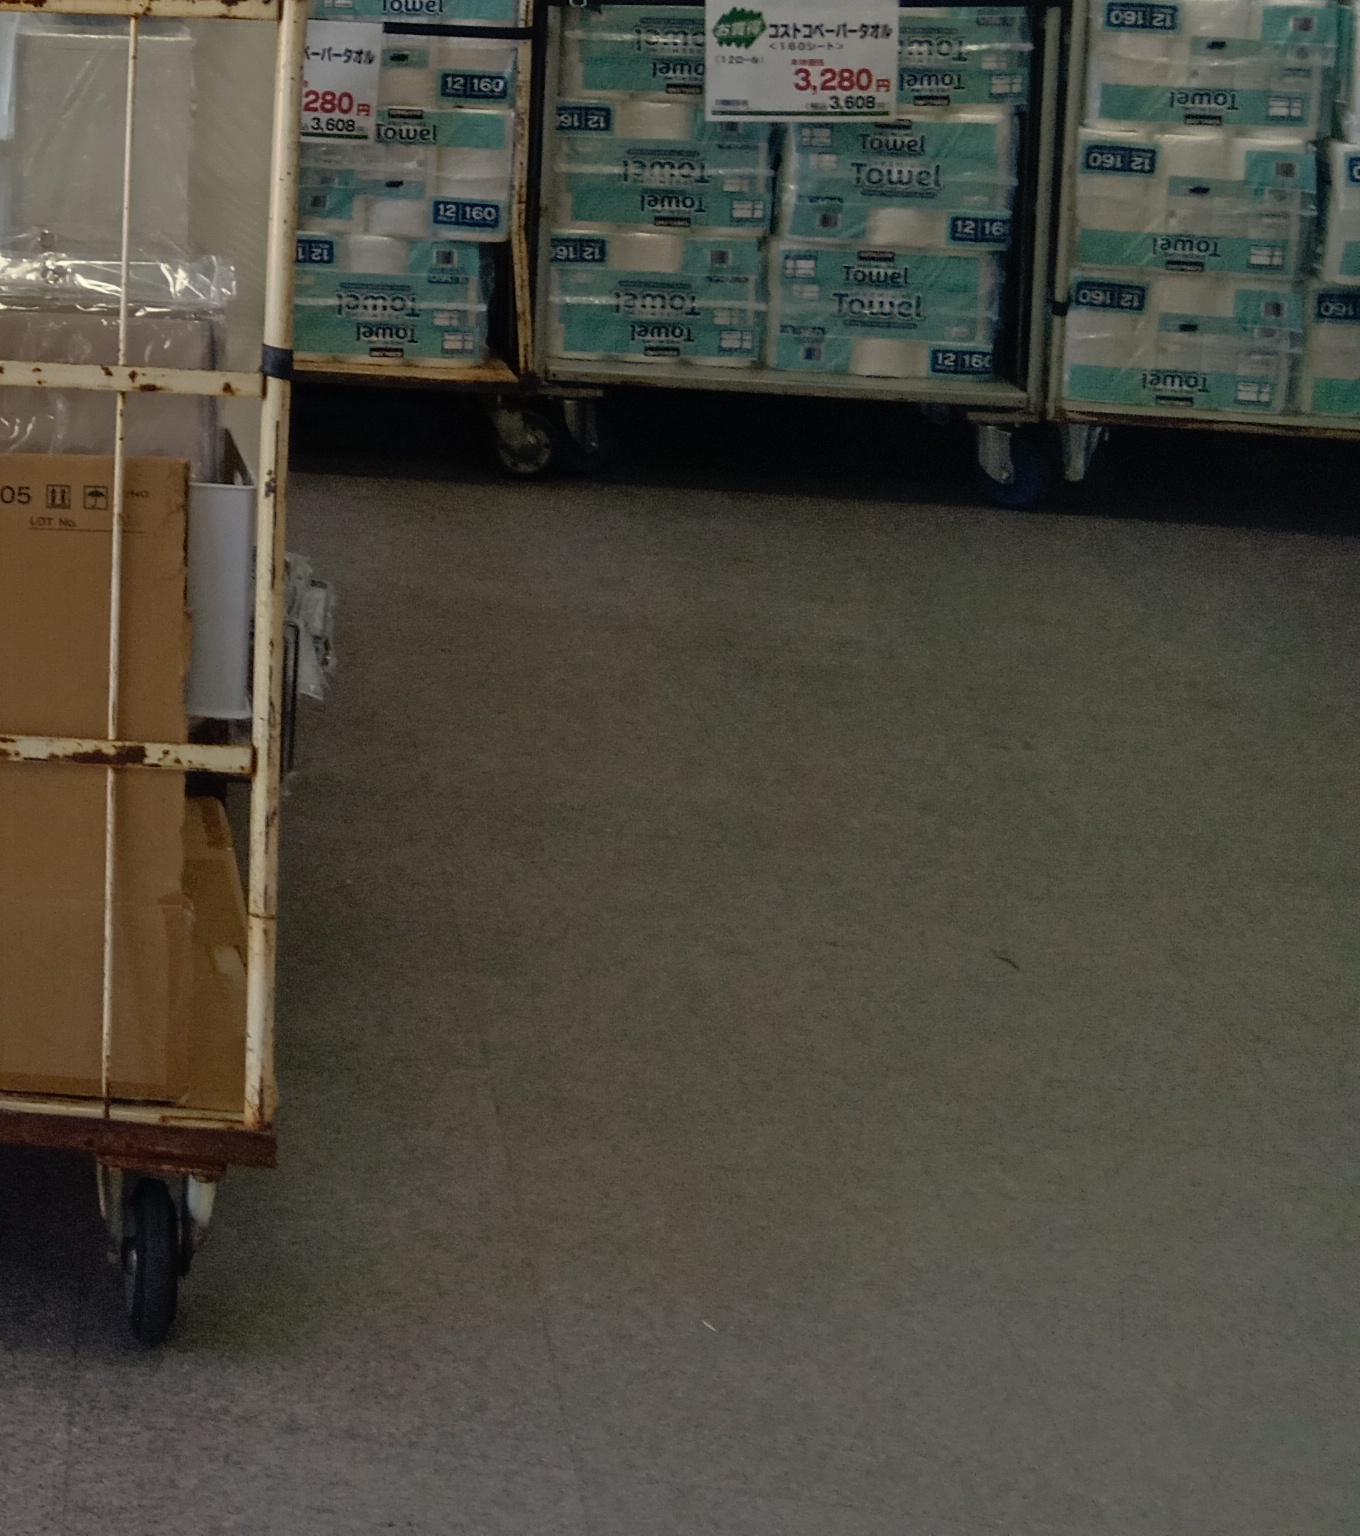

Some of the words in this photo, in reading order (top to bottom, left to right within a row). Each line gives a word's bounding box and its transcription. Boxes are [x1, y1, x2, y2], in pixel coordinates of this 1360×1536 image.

[1110, 11, 1143, 25] 160
[1152, 14, 1172, 27] 12
[446, 77, 464, 89] 12
[473, 78, 504, 92] 160
[1169, 91, 1239, 110] Towel
[587, 116, 605, 128] 12
[858, 134, 925, 153] Towel
[1088, 155, 1121, 169] 160
[1130, 157, 1151, 170] 12
[851, 162, 941, 187] Towel
[640, 194, 706, 213] Towel
[438, 204, 456, 217] 12
[465, 206, 497, 220] 160
[953, 220, 975, 233] 12
[582, 247, 601, 259] 12
[1151, 237, 1222, 257] Towel
[842, 265, 909, 284] Towel
[833, 293, 922, 318] Towel
[1120, 294, 1140, 307] 12
[355, 325, 419, 343] Towel
[630, 324, 694, 342] Towel
[936, 353, 956, 366] 12
[31, 517, 54, 527] LOT
